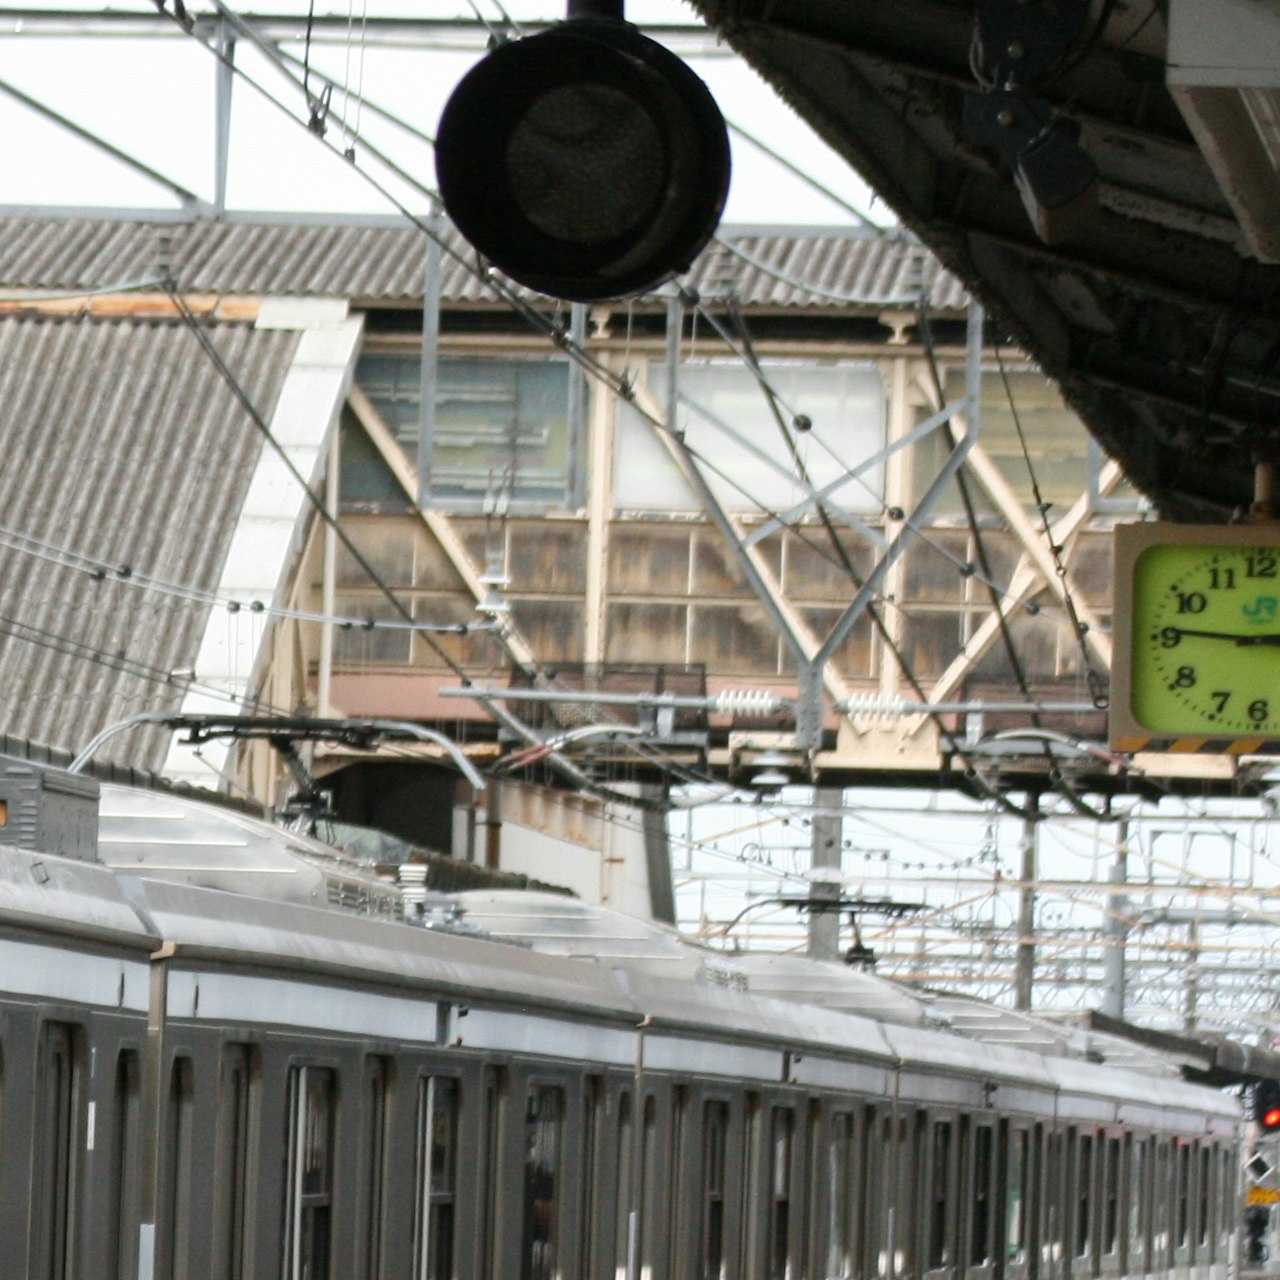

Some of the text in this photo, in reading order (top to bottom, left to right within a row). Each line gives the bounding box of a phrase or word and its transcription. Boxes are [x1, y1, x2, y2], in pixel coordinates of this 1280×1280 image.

[1245, 556, 1277, 578] 12
[1208, 567, 1236, 590] 11
[1176, 592, 1207, 614] 10
[1242, 595, 1278, 617] JR
[1160, 626, 1182, 648] 9
[1175, 666, 1197, 688] 8
[1210, 692, 1231, 713] 7
[1247, 699, 1269, 721] 6
